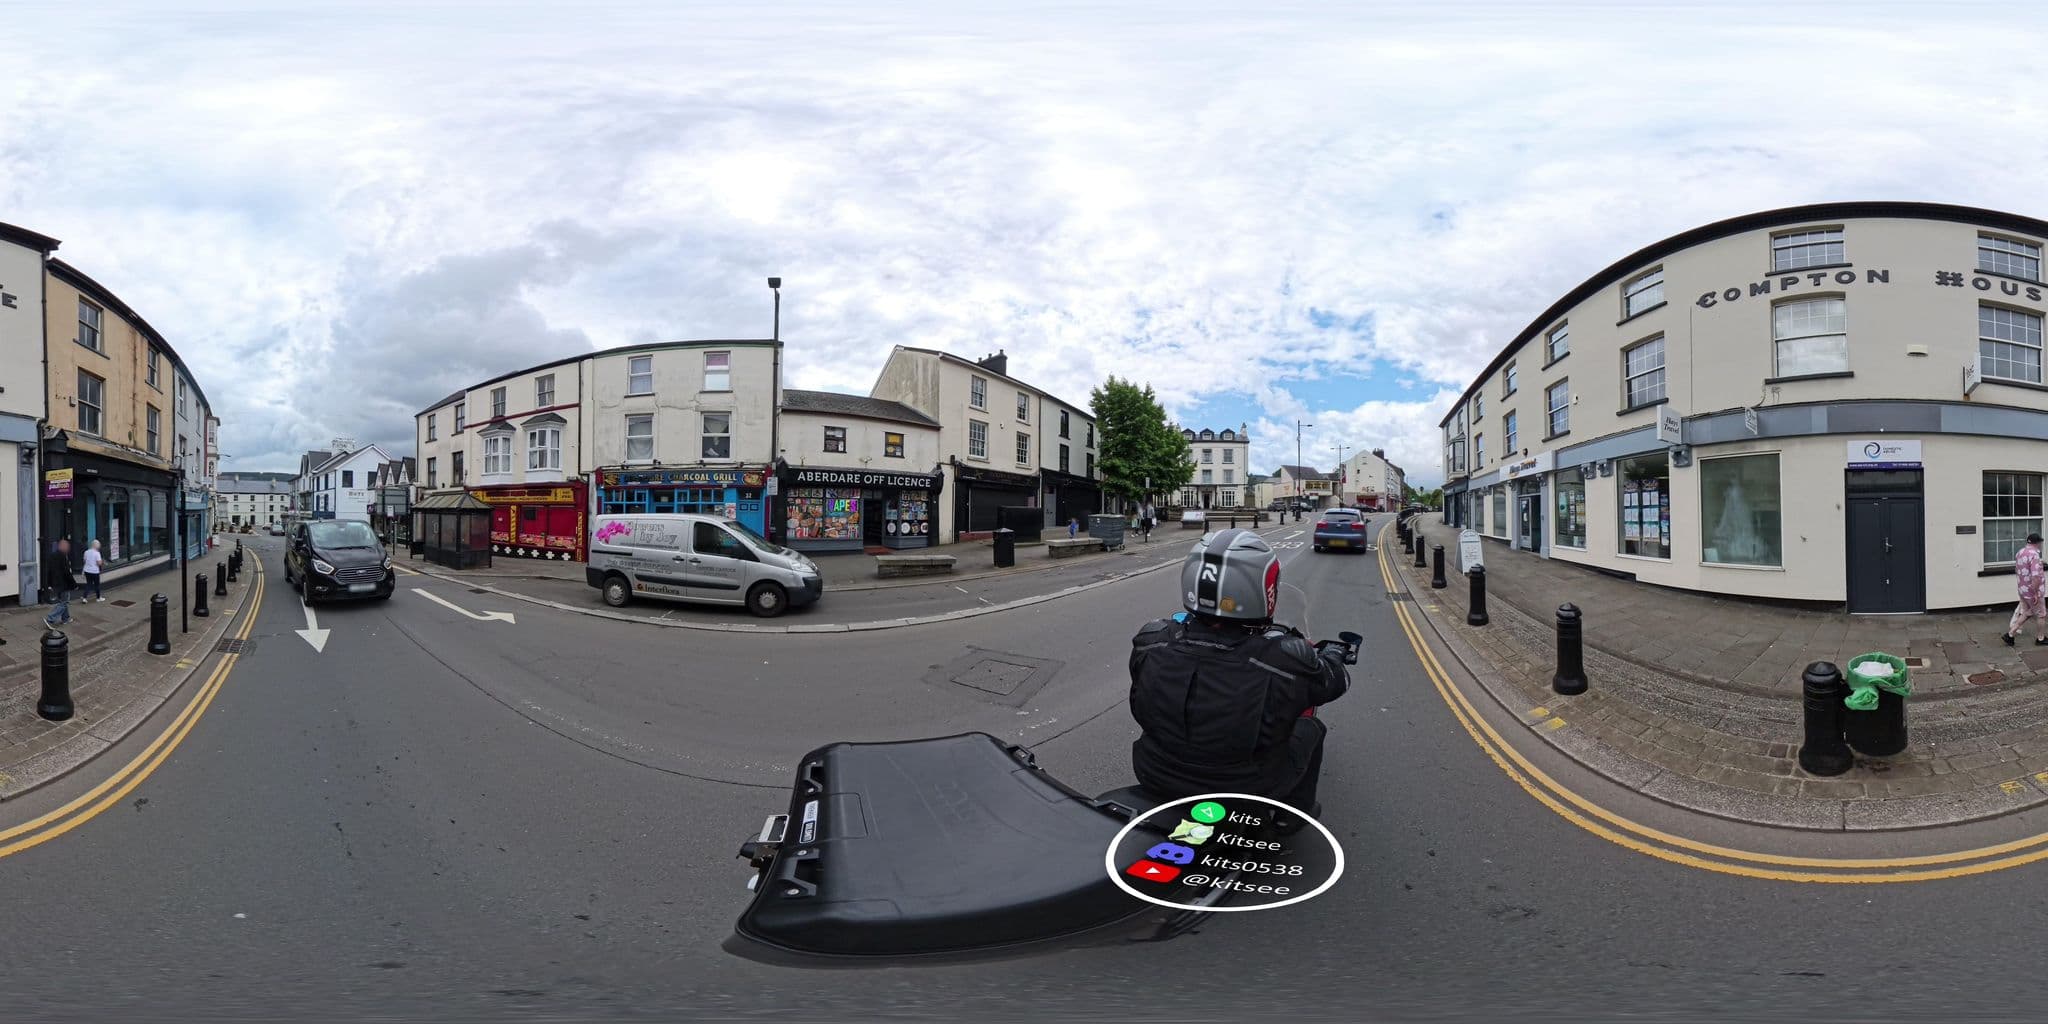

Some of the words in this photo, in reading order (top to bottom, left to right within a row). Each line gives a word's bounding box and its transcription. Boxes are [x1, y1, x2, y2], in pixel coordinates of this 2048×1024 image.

[1695, 269, 1890, 309] COMPTON
[1666, 416, 1679, 427] Hays
[1663, 423, 1680, 434] Travel
[668, 472, 711, 482] CHARCOAL
[713, 472, 737, 481] GRILL
[797, 471, 861, 484] ABERDARE
[863, 474, 885, 484] OFF
[887, 477, 931, 488] LICENCE
[645, 584, 680, 595] Interflora
